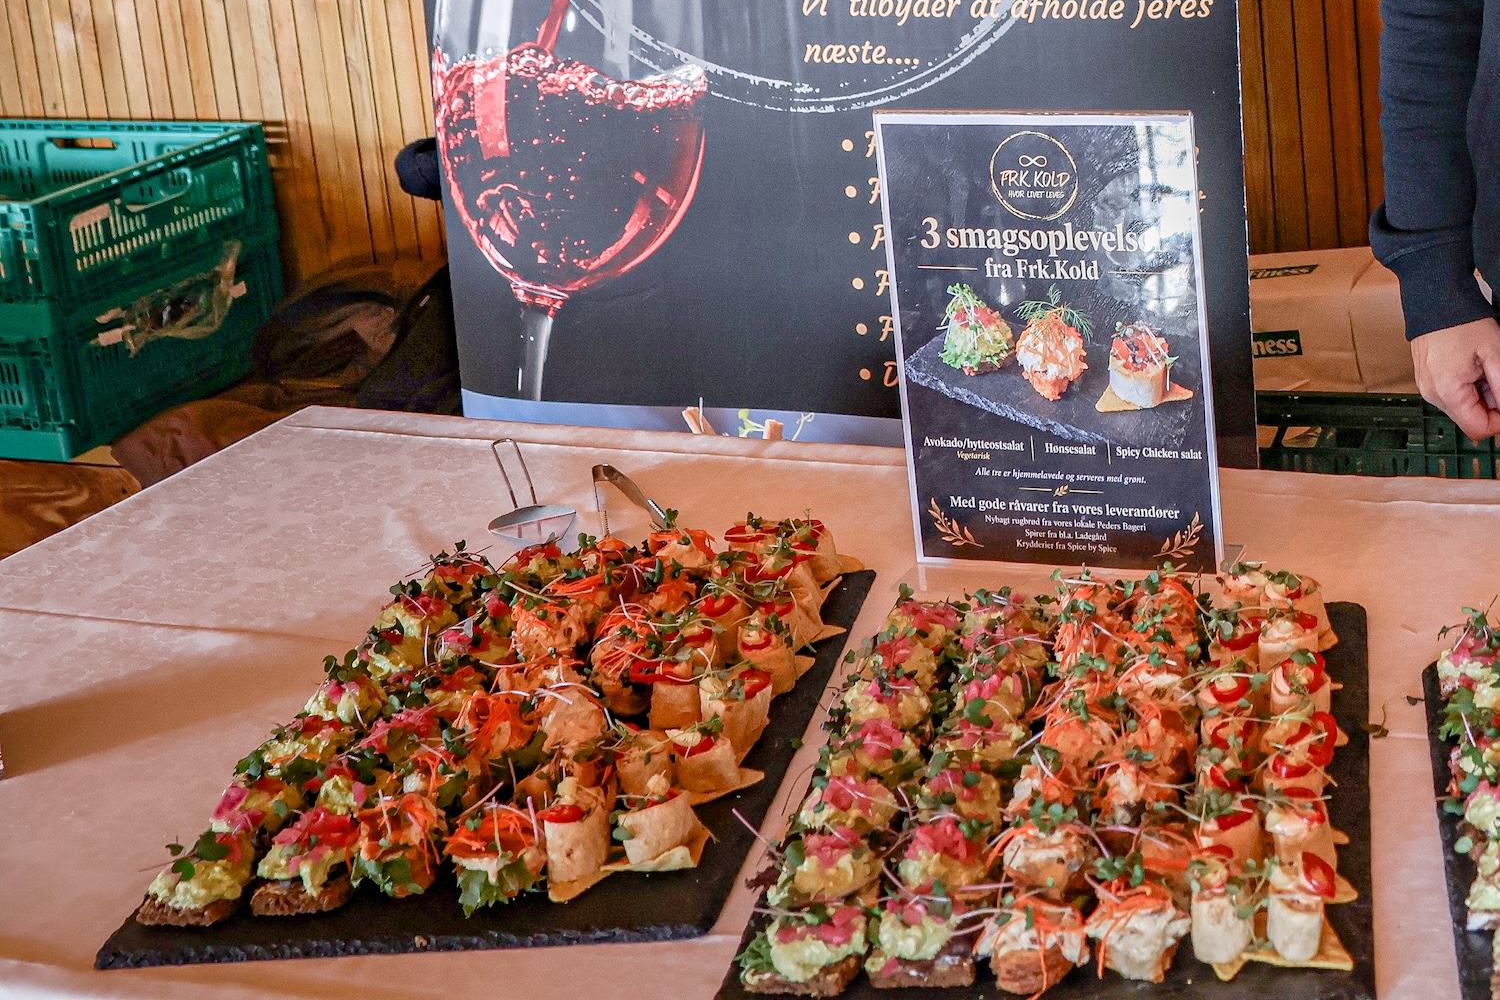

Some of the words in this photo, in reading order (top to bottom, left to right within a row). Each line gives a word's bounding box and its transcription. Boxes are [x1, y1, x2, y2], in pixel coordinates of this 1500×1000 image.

[804, 41, 920, 65] næste....
[1033, 170, 1070, 187] KOLD
[1008, 190, 1024, 199] HVOR
[1027, 191, 1045, 199] LIVET
[1045, 191, 1064, 199] LEVES
[920, 217, 940, 249] 3
[985, 257, 1012, 278] fra
[1016, 258, 1100, 281] Frk.Kold
[924, 436, 1024, 451] Avokado/hytteostsalat
[1045, 443, 1096, 455] Hønsesalat
[956, 450, 990, 461] Vegetarisk
[1116, 446, 1140, 459] Spicy
[1142, 447, 1179, 459] Chicken
[1181, 449, 1202, 460] salat
[975, 467, 991, 476] Alle
[992, 469, 1002, 477] tre
[1012, 468, 1064, 480] hjemmelavede
[1065, 473, 1075, 482] og
[1075, 474, 1104, 482] serveres
[1107, 474, 1122, 483] med
[1124, 475, 1147, 485] grønt.
[949, 495, 975, 508] Med
[978, 498, 1006, 512] gode
[1008, 499, 1049, 513] råvarer
[1052, 501, 1069, 513] fra
[1071, 505, 1103, 516] vores
[1105, 503, 1180, 519] leverandører
[984, 514, 1010, 525] Nybagt
[1011, 517, 1040, 527] rugbrød
[1041, 518, 1052, 527] fra
[1053, 520, 1073, 528] vores
[1073, 519, 1096, 529] lokale
[1097, 522, 1121, 531] Peders
[1122, 523, 1146, 533] Bageri
[1025, 528, 1046, 538] Spirer
[1047, 529, 1057, 539] fra
[1058, 530, 1073, 539] bl.a.
[1075, 530, 1107, 542] Ladegård
[1016, 539, 1054, 550] Krydderier
[1055, 540, 1066, 550] fra
[1067, 541, 1087, 551] Spice
[1087, 542, 1097, 553] by
[1098, 543, 1117, 553] Spice
